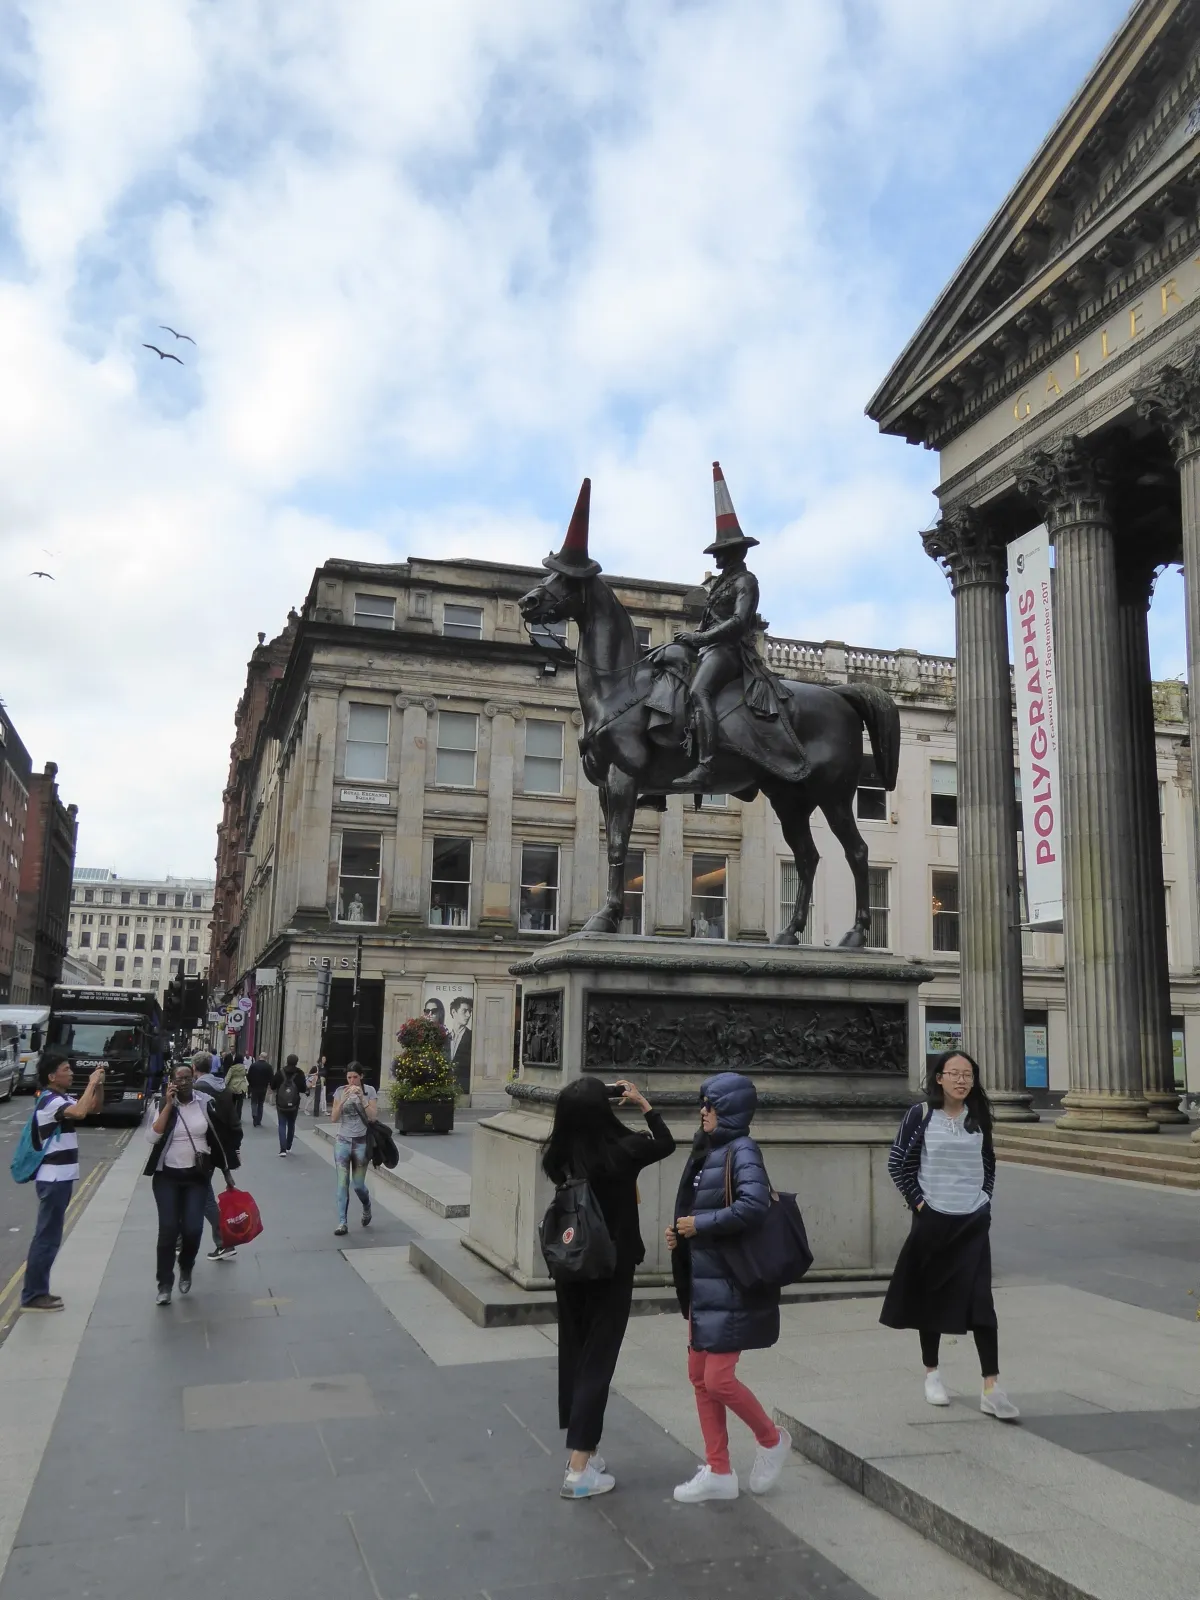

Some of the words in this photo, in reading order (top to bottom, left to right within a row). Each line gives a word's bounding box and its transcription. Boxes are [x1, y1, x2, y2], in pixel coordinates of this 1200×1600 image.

[1013, 256, 1200, 421] GALLER
[1043, 608, 1052, 666] September
[1045, 670, 1052, 680] 17
[1018, 589, 1056, 865] POLYGRAPHS
